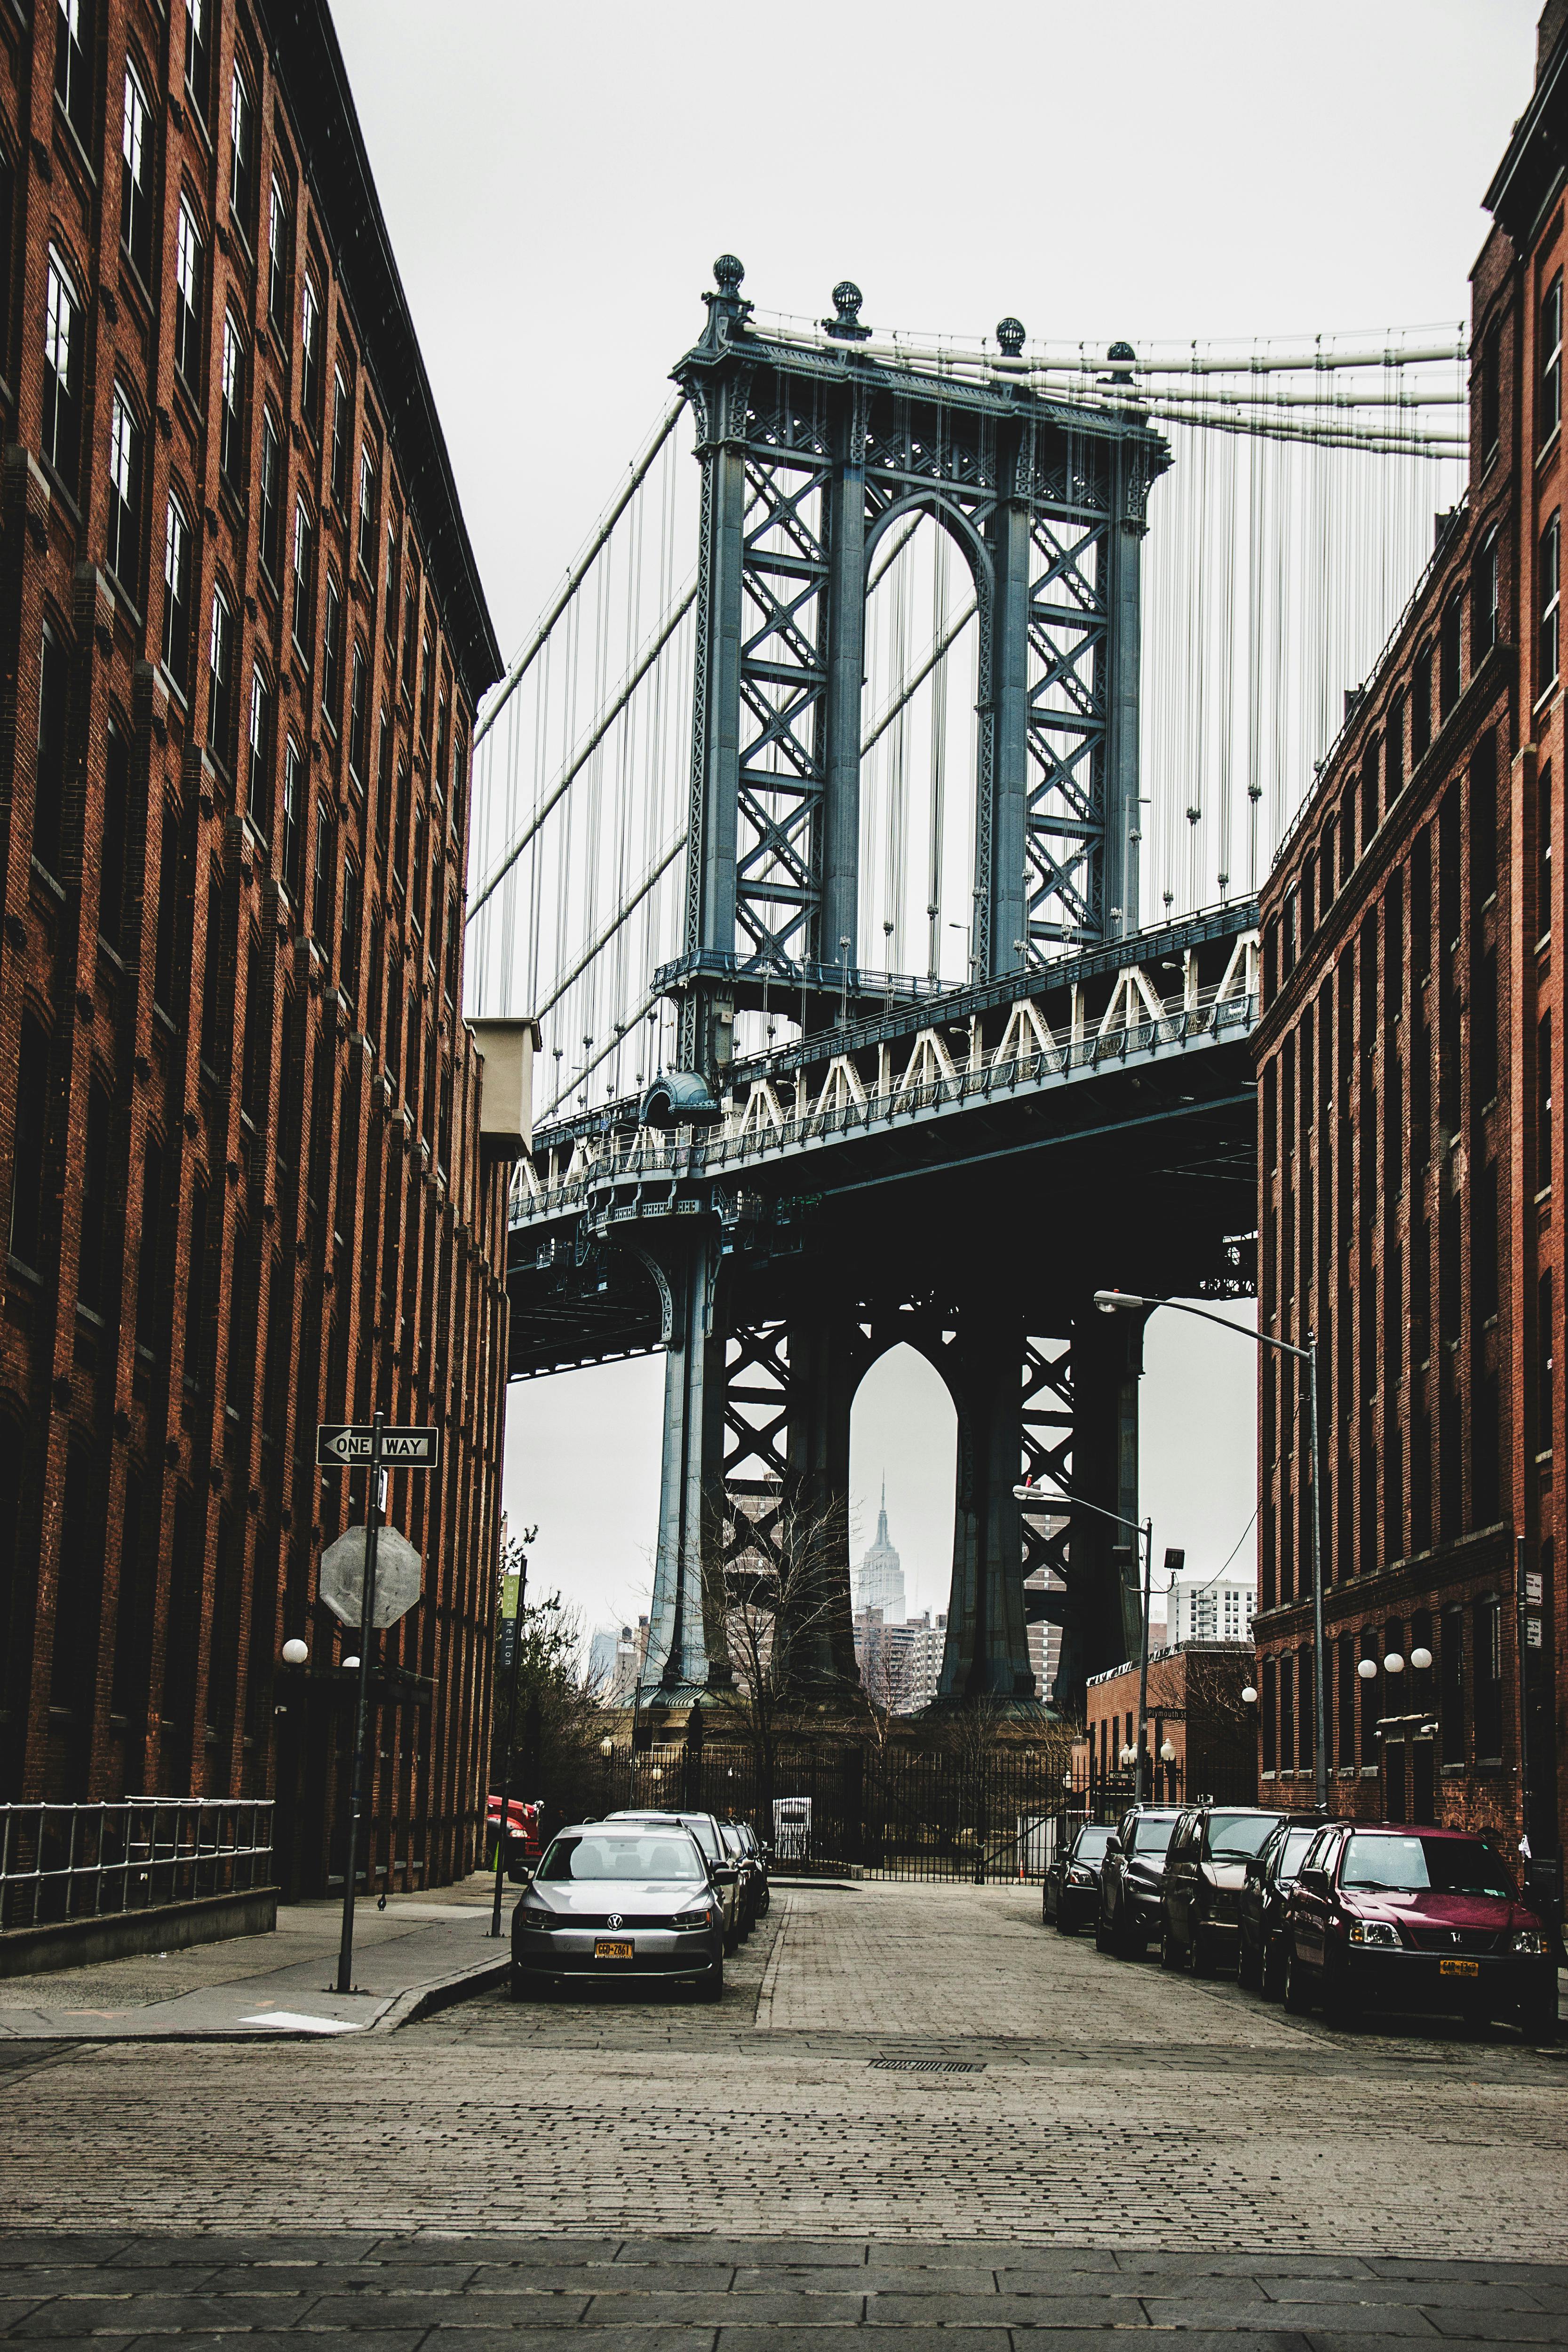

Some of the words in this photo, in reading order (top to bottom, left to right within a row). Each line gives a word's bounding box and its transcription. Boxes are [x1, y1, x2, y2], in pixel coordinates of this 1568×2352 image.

[336, 1438, 370, 1453] ONE
[386, 1439, 422, 1454] WAY
[507, 1579, 516, 1615] Smack
[505, 1621, 514, 1665] Mellon
[1148, 1709, 1178, 1718] Plymouth
